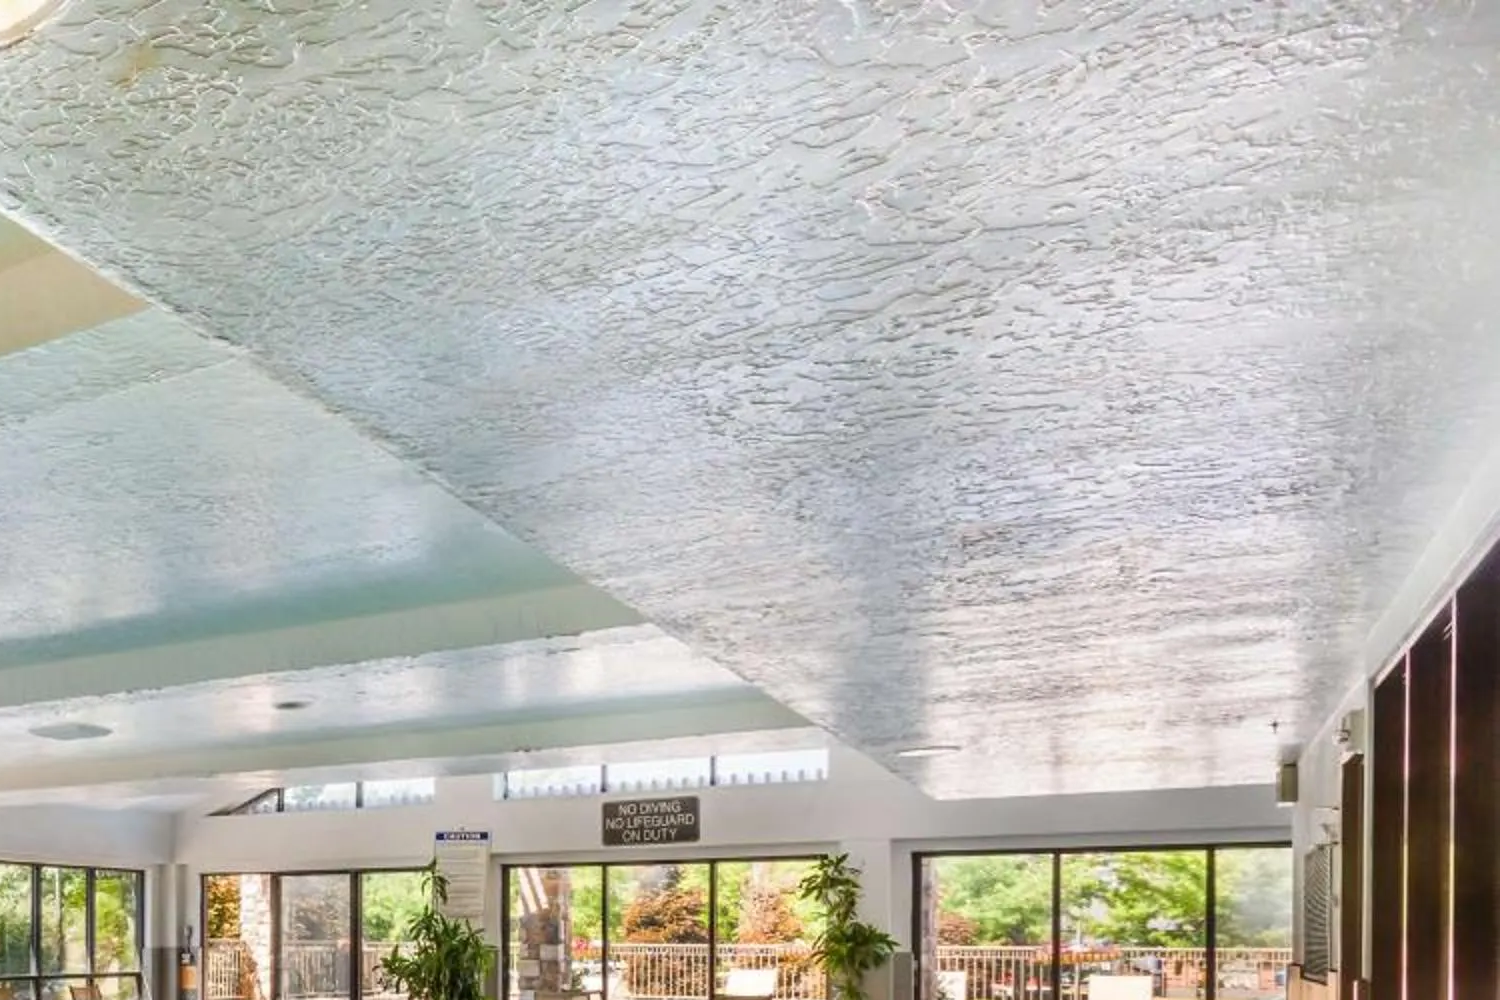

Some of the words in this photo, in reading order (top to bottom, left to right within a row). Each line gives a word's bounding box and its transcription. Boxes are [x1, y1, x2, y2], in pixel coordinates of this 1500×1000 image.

[619, 804, 637, 816] NO
[639, 800, 682, 815] DIVING
[605, 817, 625, 830] NO
[626, 813, 695, 829] LIFEGUARD
[622, 829, 640, 842] ON
[643, 827, 677, 841] DUTY
